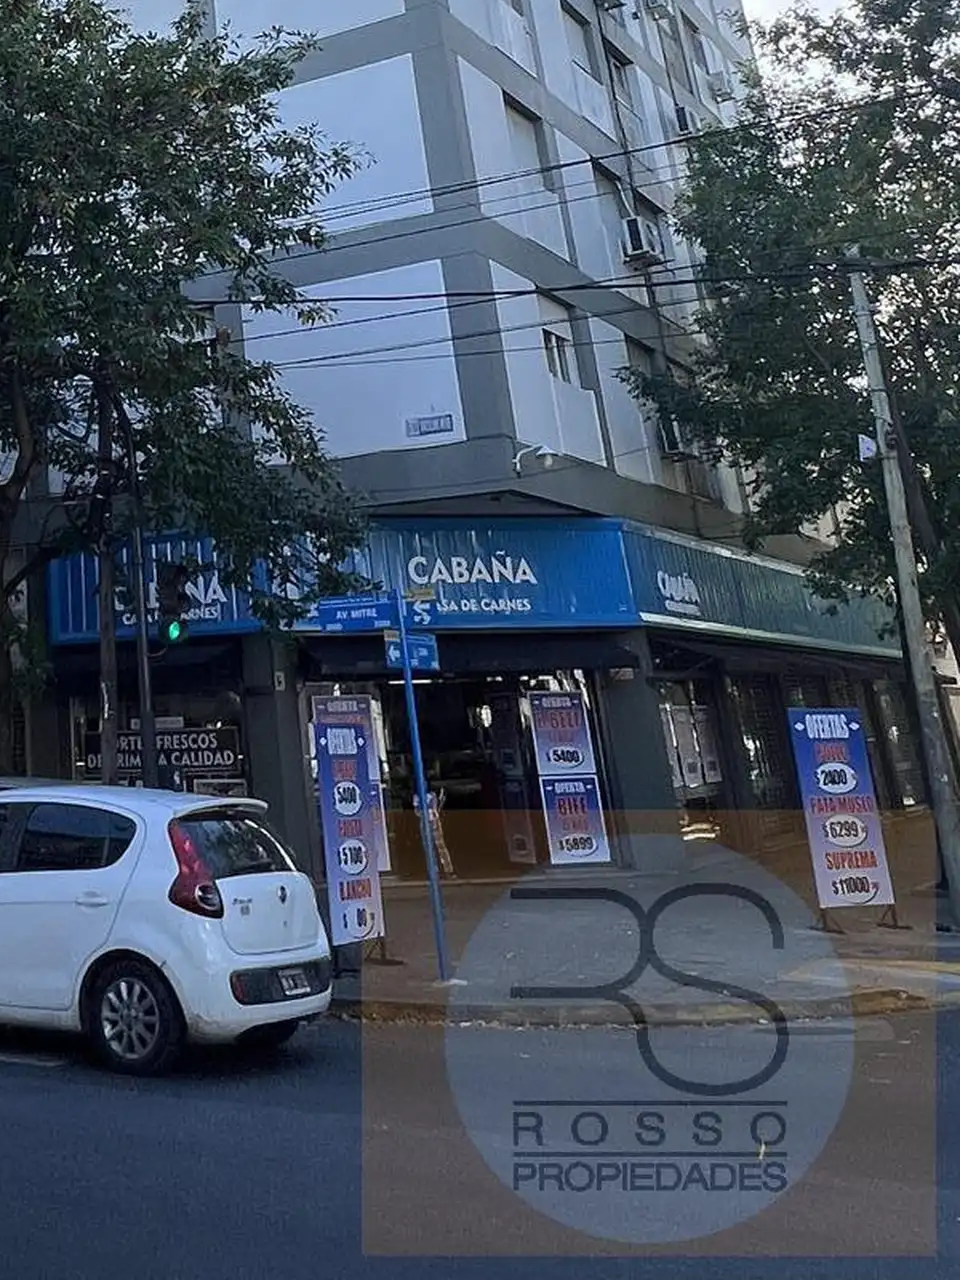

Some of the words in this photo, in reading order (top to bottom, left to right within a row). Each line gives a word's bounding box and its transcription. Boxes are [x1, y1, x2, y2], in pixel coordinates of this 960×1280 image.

[407, 549, 538, 585] CABAÑA
[461, 599, 478, 611] DE
[481, 598, 532, 612] CARNES
[805, 713, 850, 739] OFERTAS
[156, 732, 218, 750] FRESCOS
[171, 751, 235, 767] CALIDAD
[824, 850, 878, 870] SUPREMA
